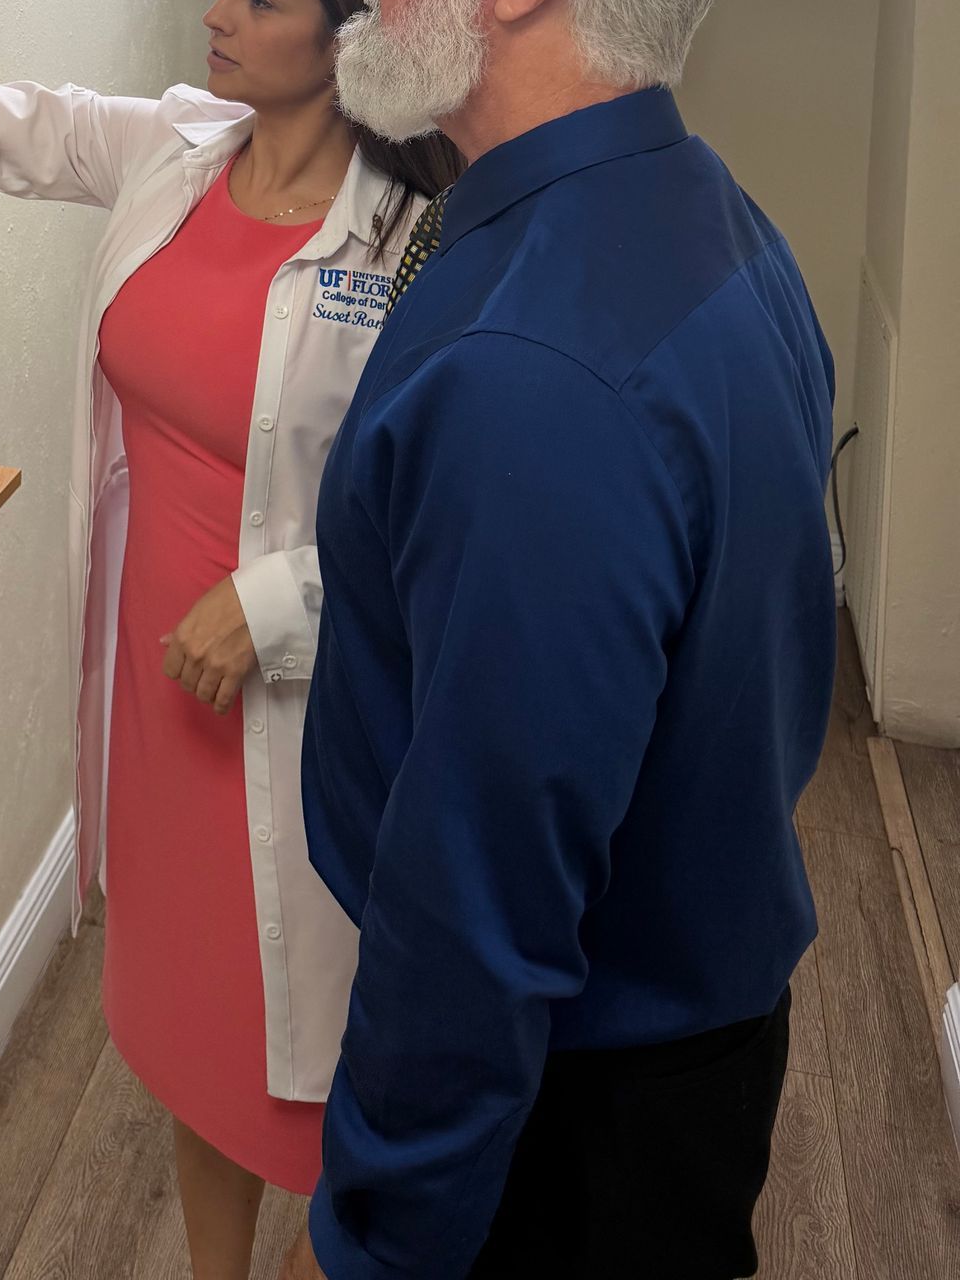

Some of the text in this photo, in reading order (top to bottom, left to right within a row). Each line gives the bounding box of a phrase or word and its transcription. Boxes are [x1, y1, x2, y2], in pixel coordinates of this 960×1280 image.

[319, 268, 347, 288] UF
[322, 290, 357, 306] College
[358, 297, 369, 307] of
[312, 303, 351, 323] Suset
